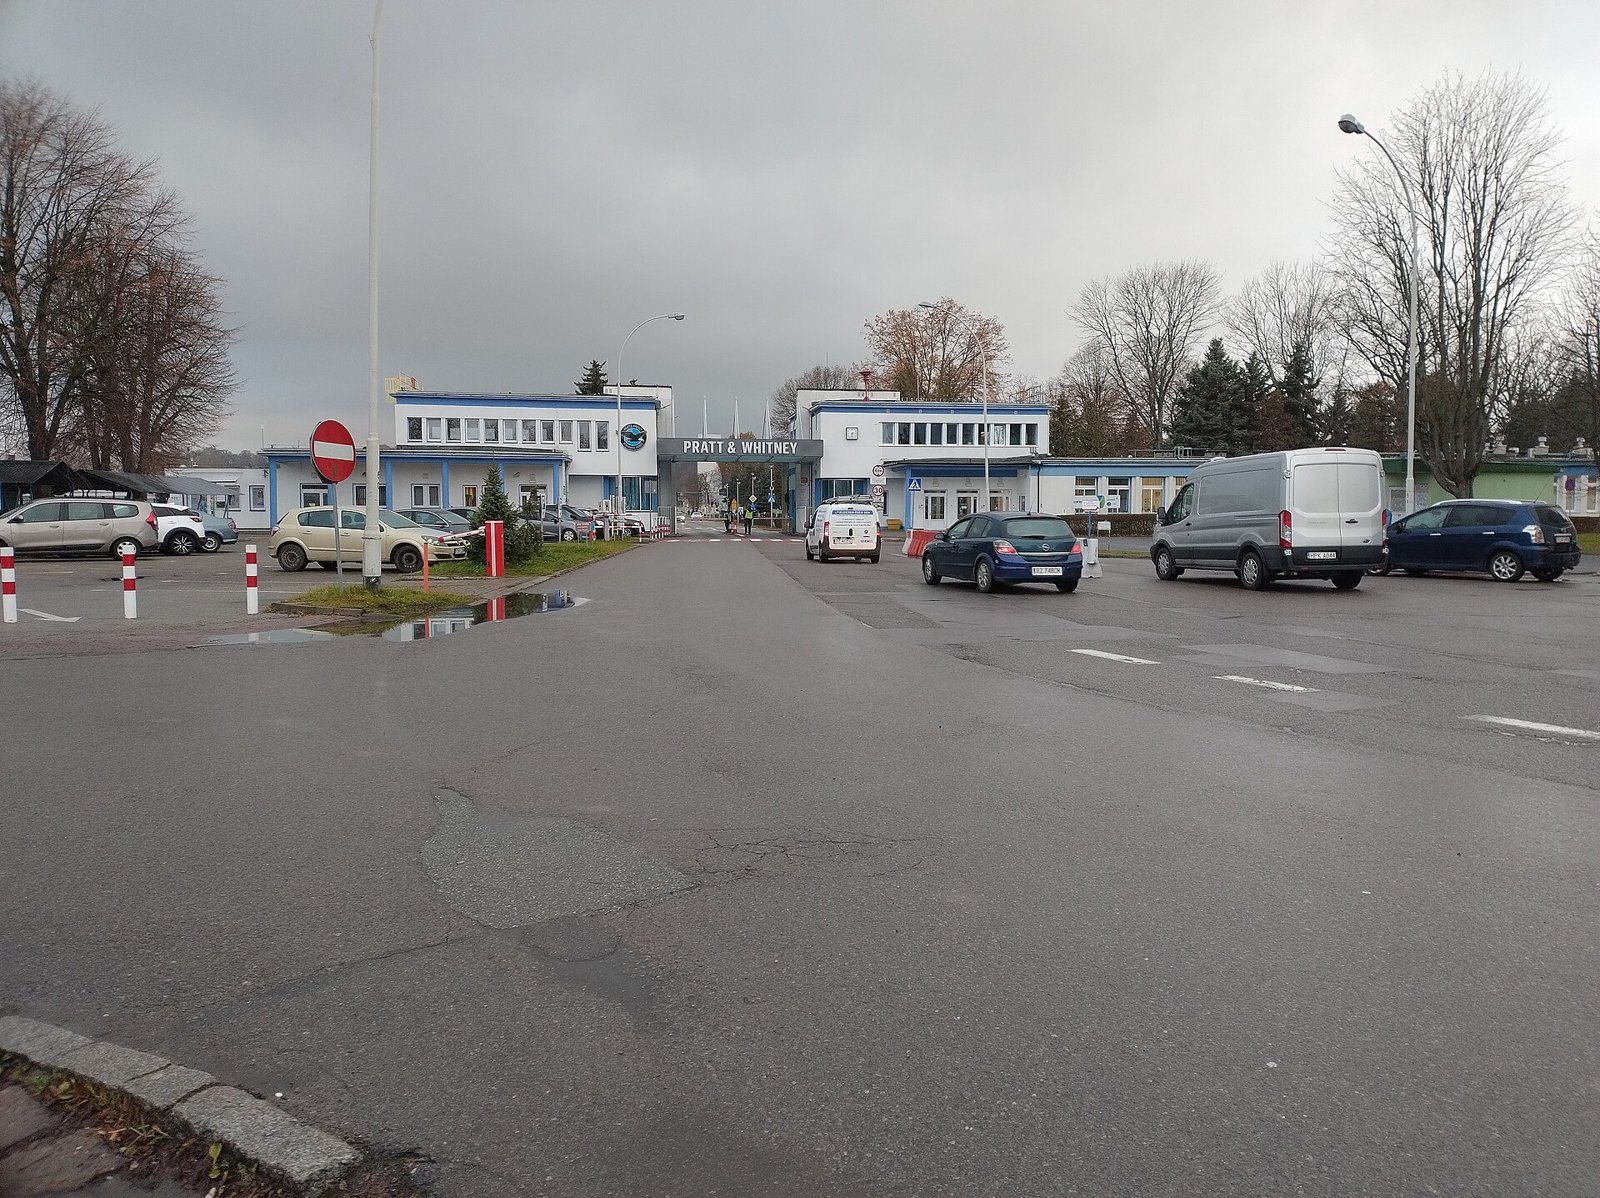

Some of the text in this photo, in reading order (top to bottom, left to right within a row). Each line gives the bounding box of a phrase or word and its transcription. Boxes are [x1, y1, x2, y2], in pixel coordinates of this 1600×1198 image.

[683, 440, 798, 454] PRATT & WHITNEY
